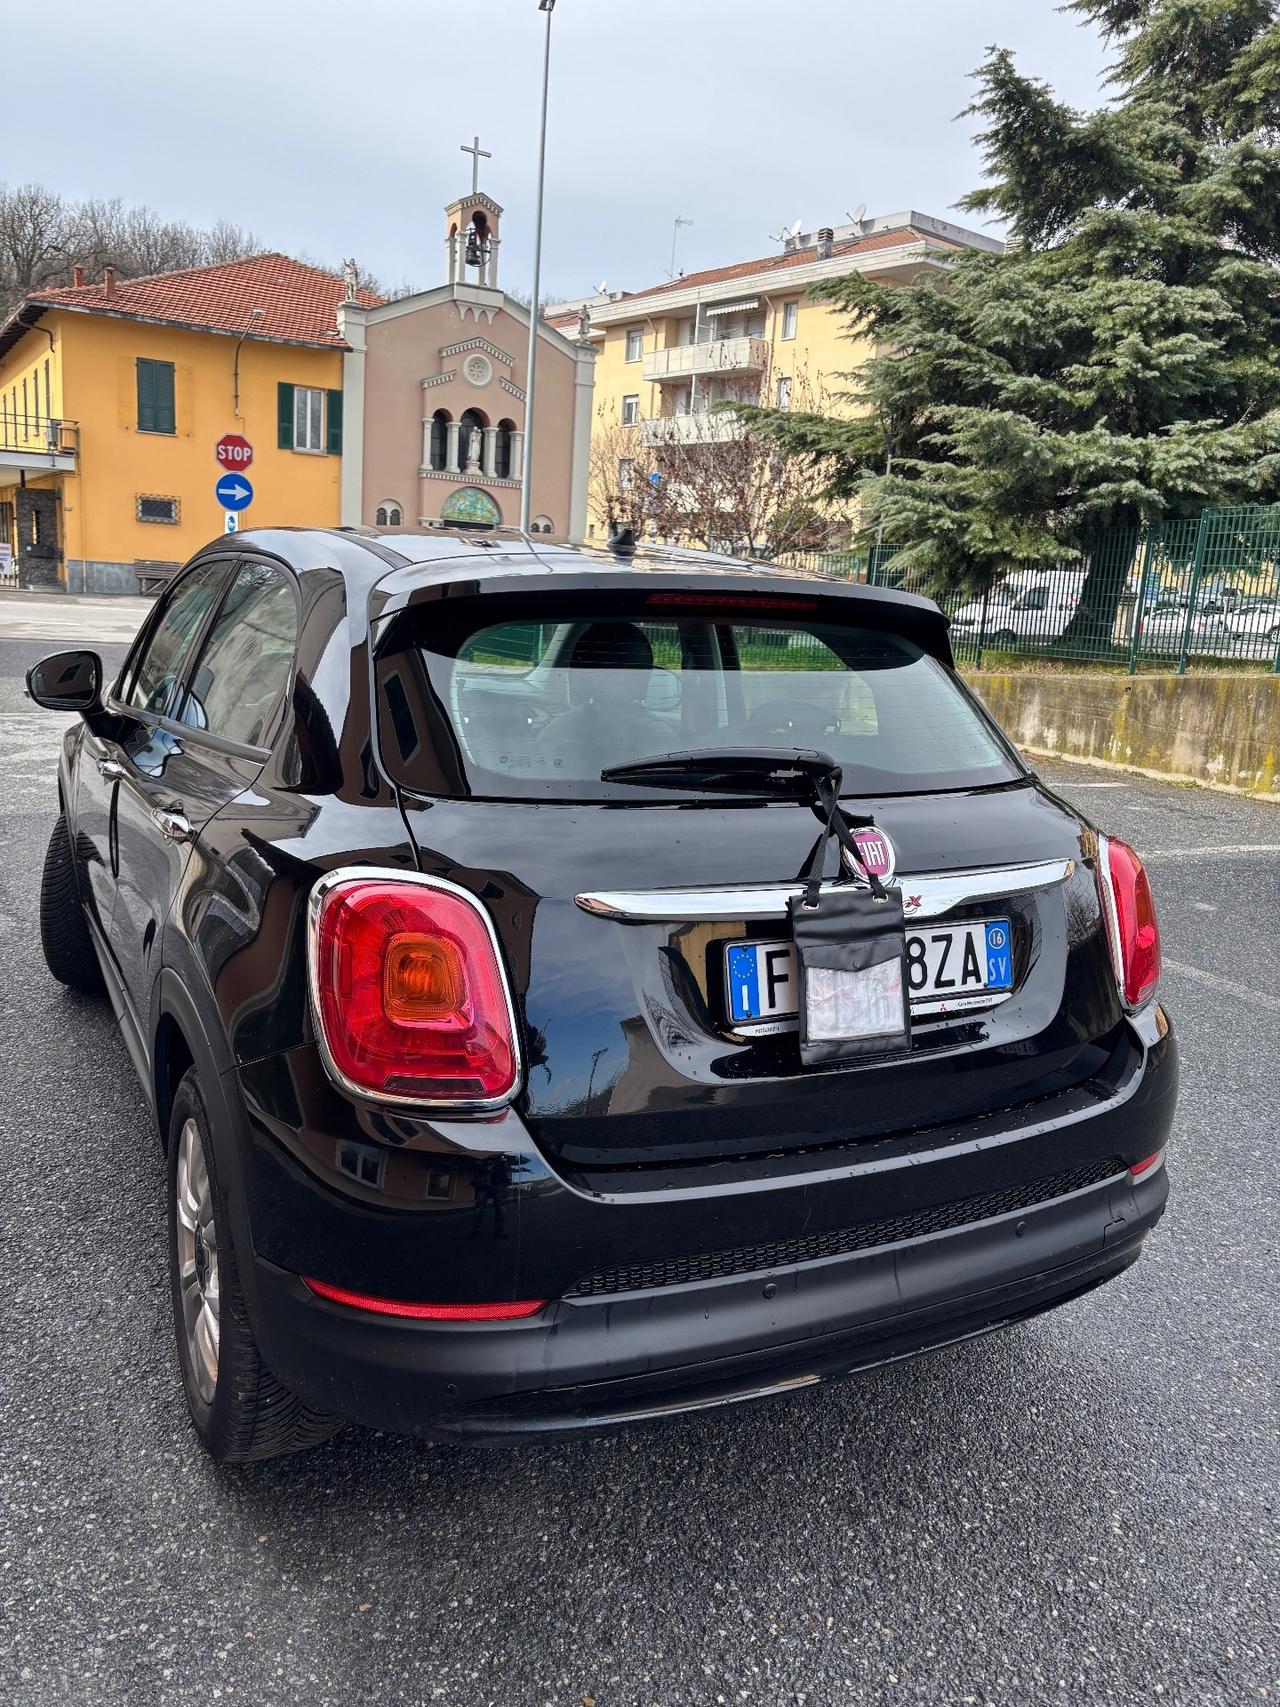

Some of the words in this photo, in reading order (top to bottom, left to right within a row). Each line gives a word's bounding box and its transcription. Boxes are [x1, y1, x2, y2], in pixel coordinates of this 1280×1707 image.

[218, 445, 251, 461] STOP
[991, 931, 1003, 945] 16
[989, 957, 1006, 982] SV
